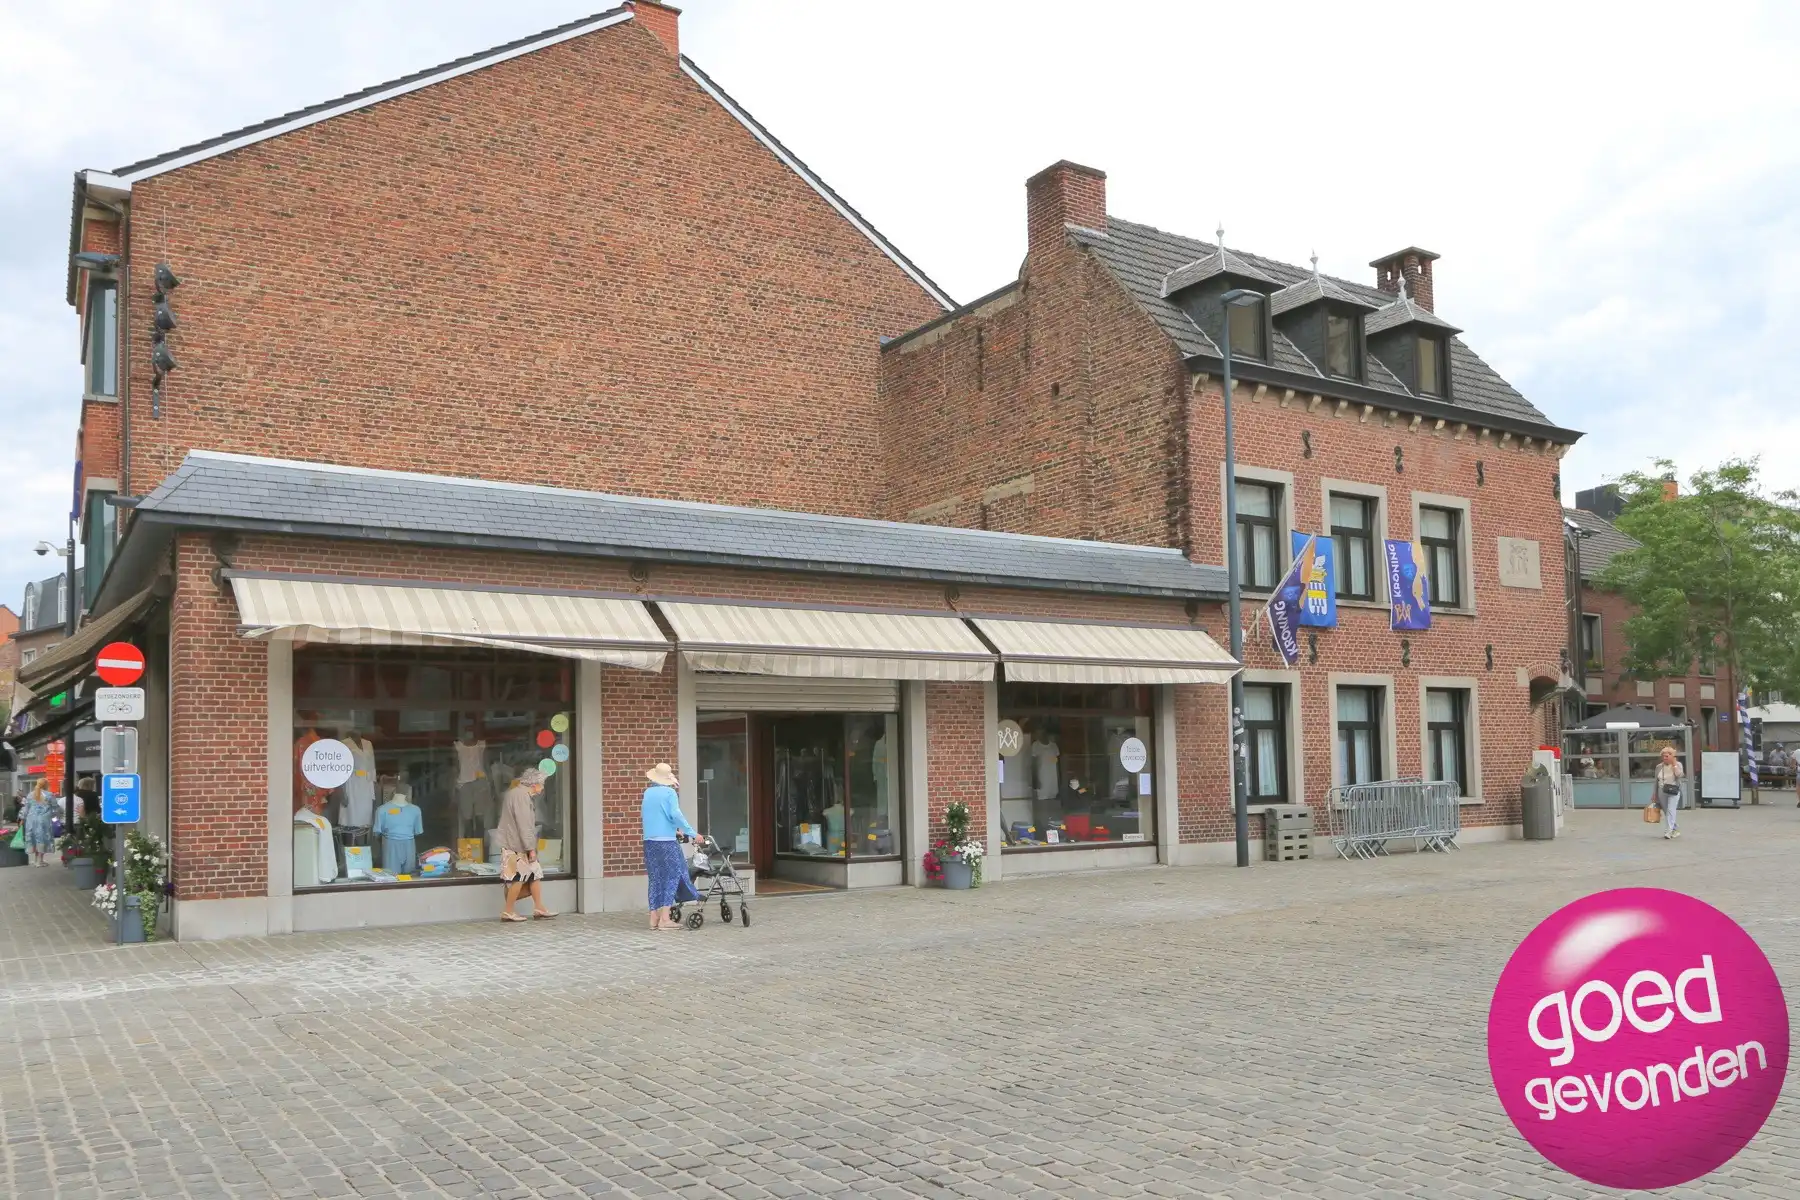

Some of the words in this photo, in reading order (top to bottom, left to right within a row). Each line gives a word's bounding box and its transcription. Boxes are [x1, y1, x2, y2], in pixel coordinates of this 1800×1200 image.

[1387, 543, 1402, 598] KRONING
[1273, 600, 1299, 656] KRONING
[303, 762, 352, 774] uitverkoop
[314, 750, 342, 761] Totale
